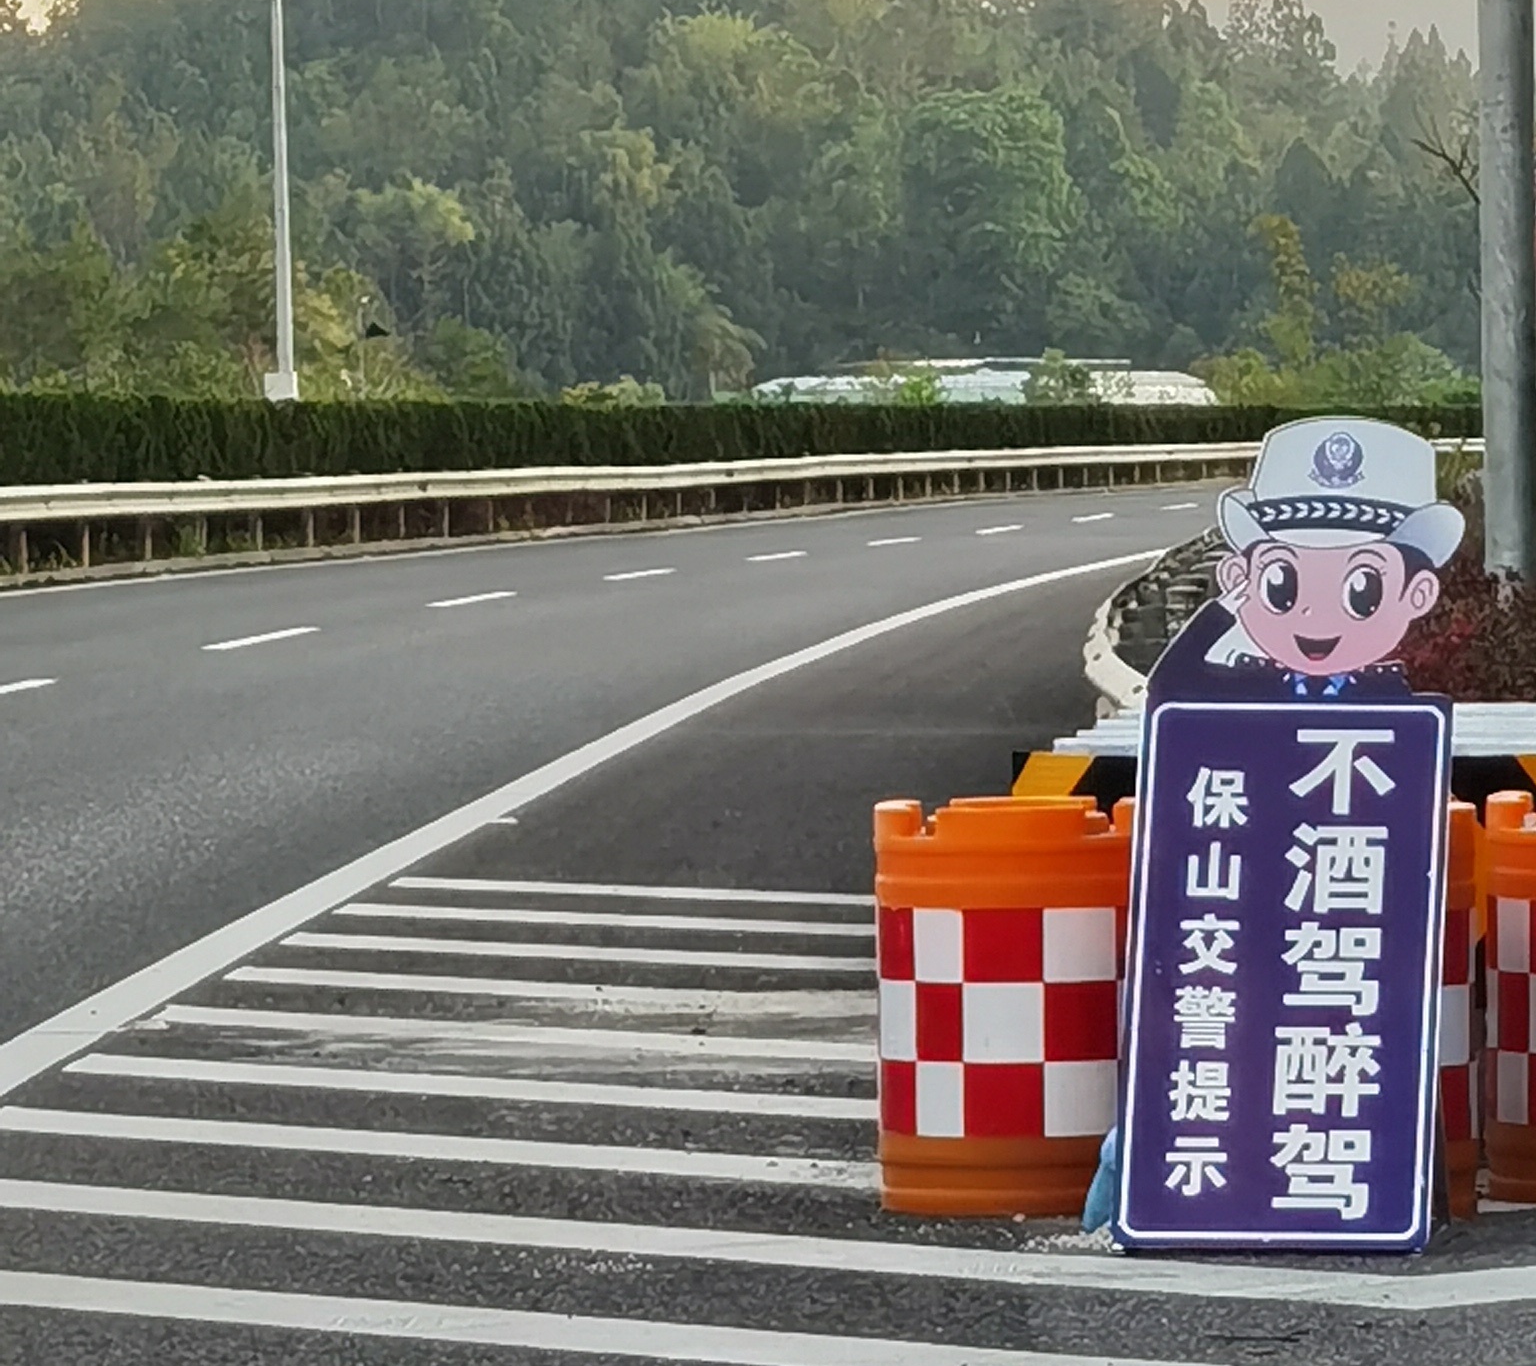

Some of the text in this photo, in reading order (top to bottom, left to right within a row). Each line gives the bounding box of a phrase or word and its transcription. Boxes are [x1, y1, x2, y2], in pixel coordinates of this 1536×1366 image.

[1164, 765, 1250, 1197] 保山交警提示
[1269, 727, 1396, 1222] 不酒驾醉驾
